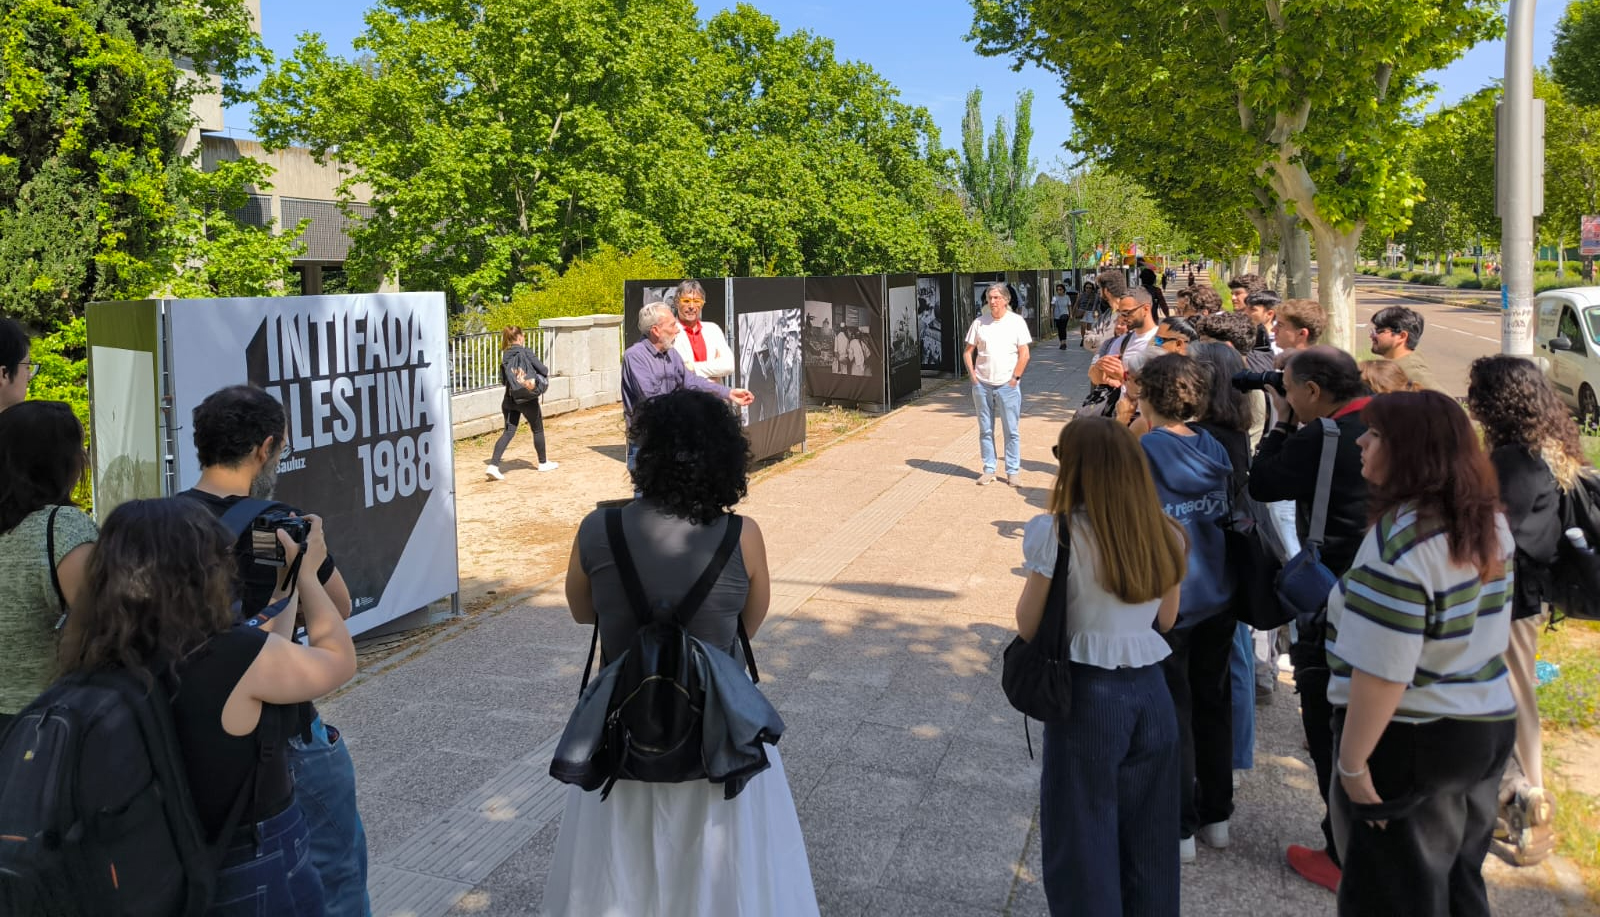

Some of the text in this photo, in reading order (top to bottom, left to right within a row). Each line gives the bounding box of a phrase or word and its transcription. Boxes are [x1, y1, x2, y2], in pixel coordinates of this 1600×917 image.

[265, 308, 427, 381] INTIFADA
[265, 367, 432, 452] LESTINA
[357, 430, 434, 509] 1988
[1175, 495, 1219, 517] ready
